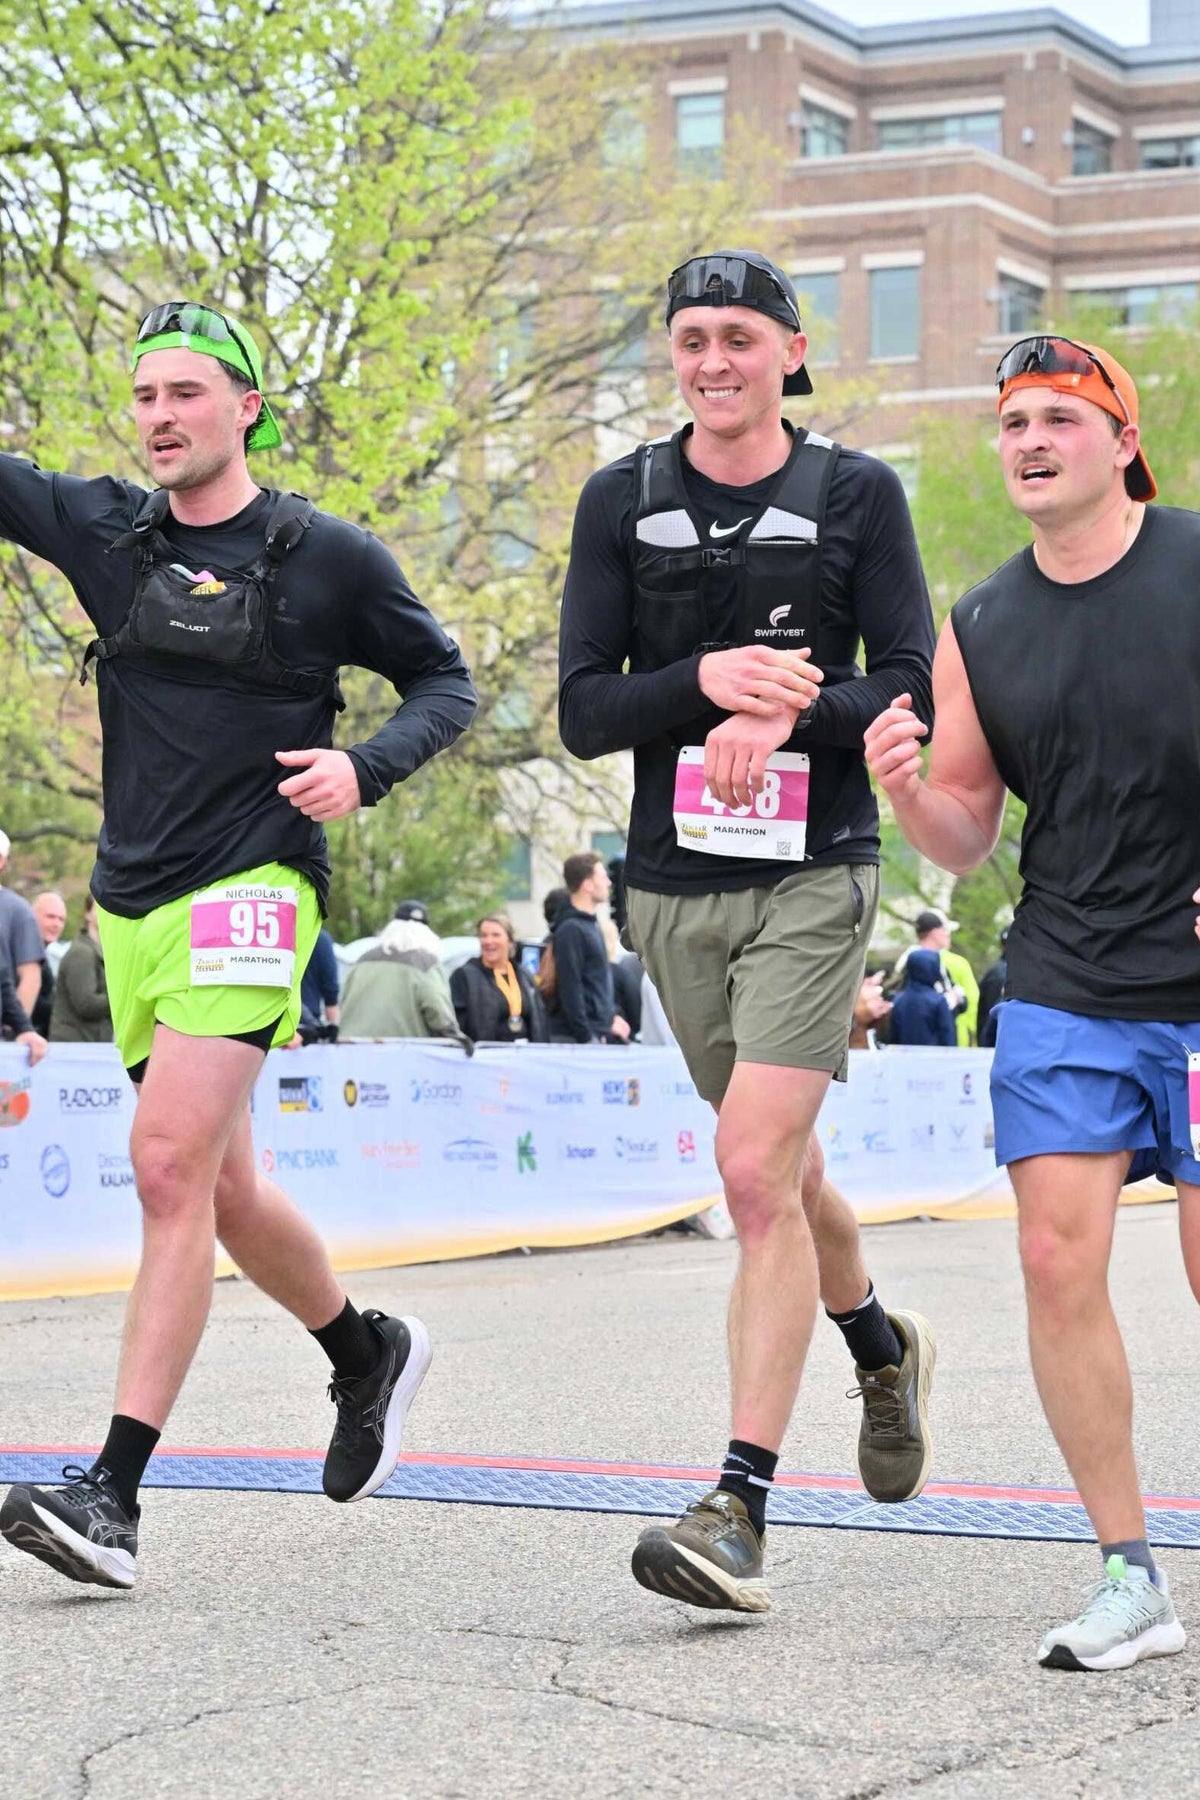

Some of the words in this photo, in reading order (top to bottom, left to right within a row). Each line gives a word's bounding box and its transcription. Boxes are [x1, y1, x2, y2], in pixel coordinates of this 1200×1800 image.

[755, 628, 805, 637] SWIFTVEST
[713, 826, 767, 836] MARATHON
[225, 889, 283, 899] NICHOLAS
[229, 902, 280, 947] 95
[230, 956, 281, 964] MARATHON
